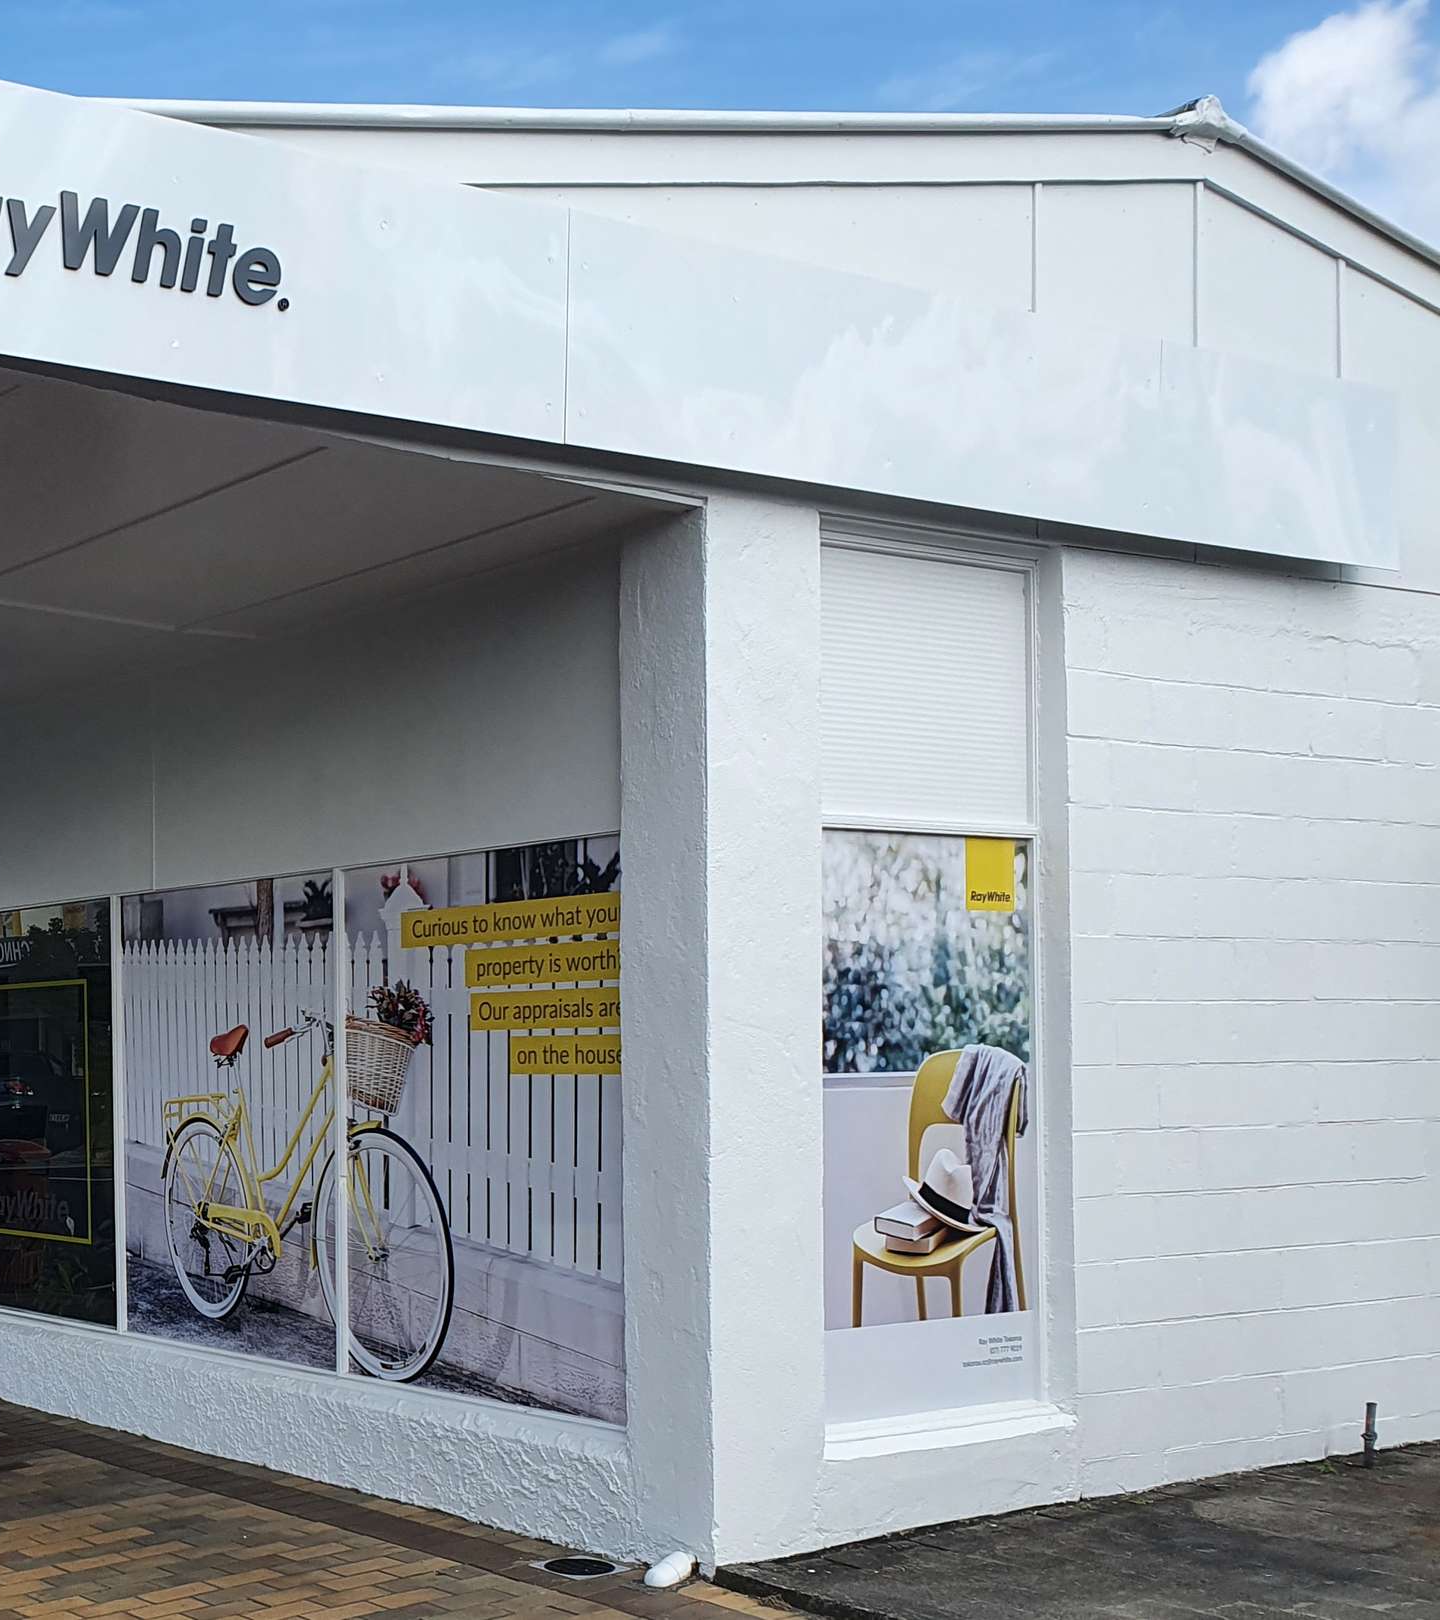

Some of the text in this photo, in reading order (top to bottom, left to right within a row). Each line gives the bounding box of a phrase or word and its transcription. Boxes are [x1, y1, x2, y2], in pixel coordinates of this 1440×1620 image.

[412, 906, 620, 938] Curious to know what you
[476, 949, 621, 981] property is worth
[478, 1001, 510, 1021] Our
[513, 997, 594, 1023] appraisals
[517, 1049, 538, 1065] on
[543, 1044, 570, 1065] the
